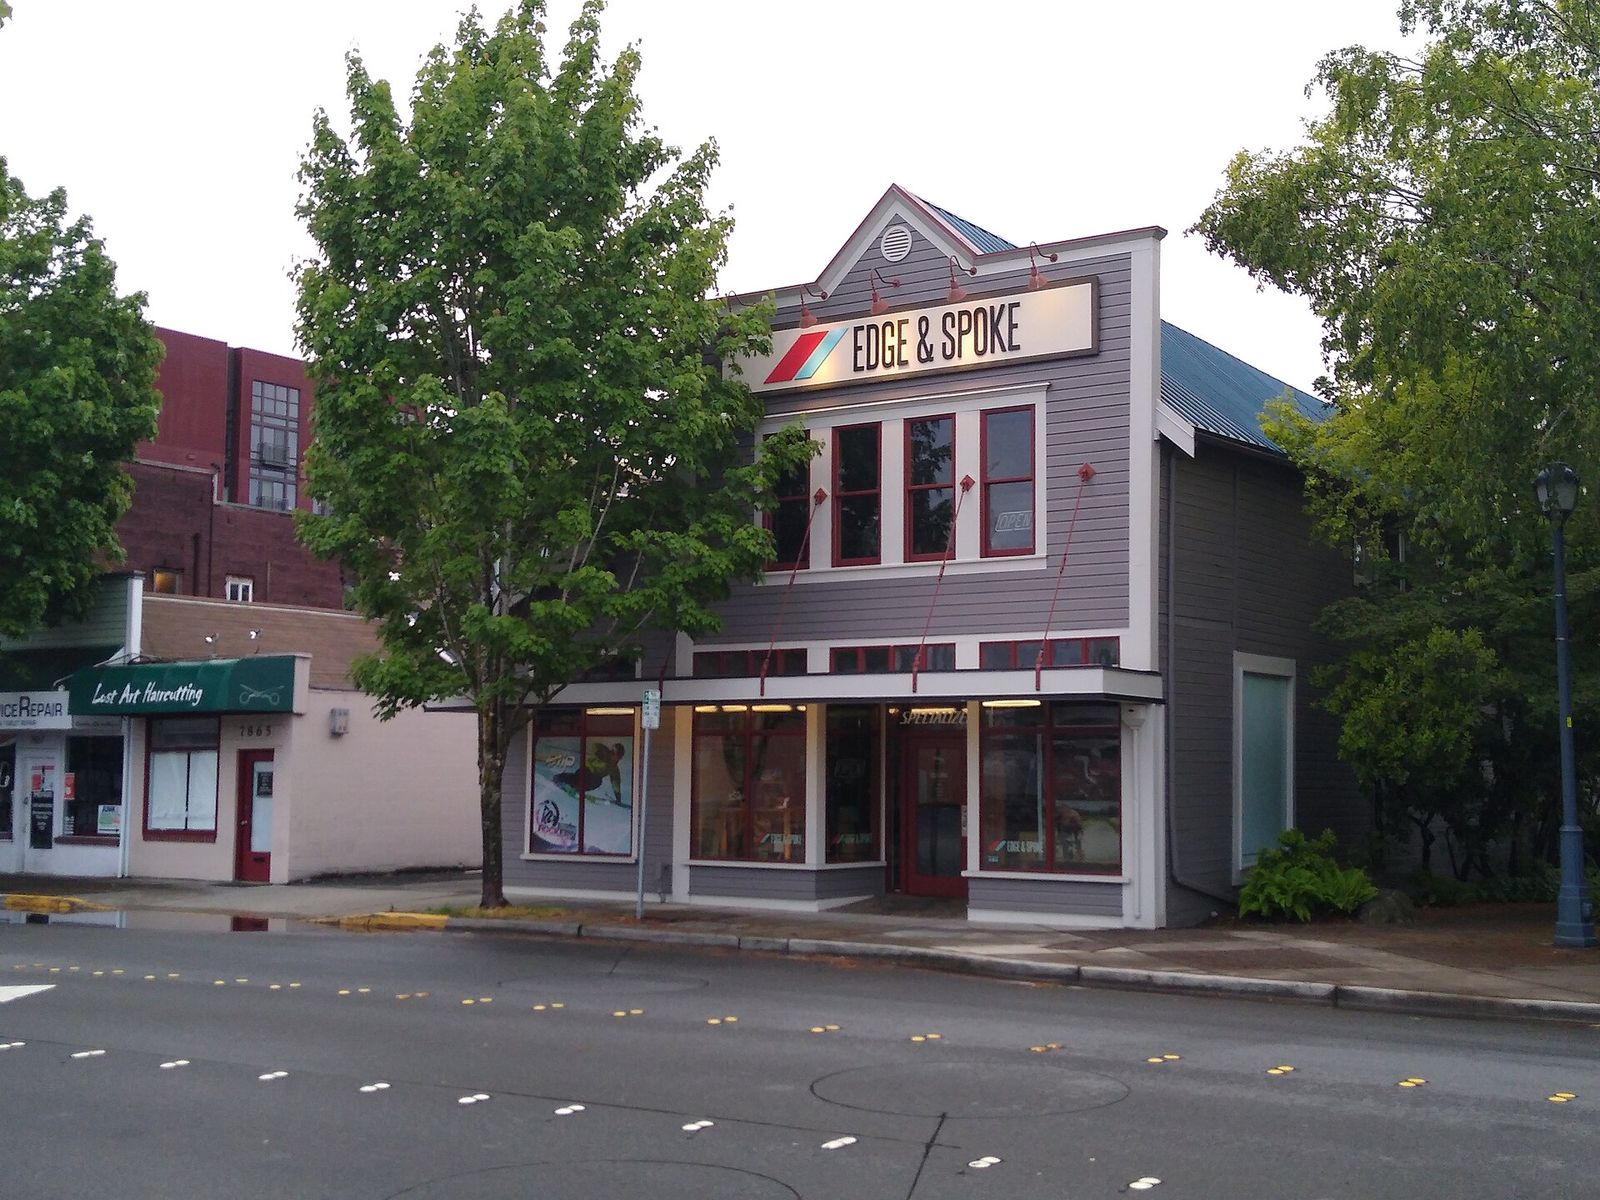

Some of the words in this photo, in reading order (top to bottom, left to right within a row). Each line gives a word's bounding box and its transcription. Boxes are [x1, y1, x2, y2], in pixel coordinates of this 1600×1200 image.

[853, 319, 909, 372] EDGE
[917, 315, 934, 364] &
[942, 301, 1021, 361] SPOKE
[92, 682, 118, 704] Lost
[119, 682, 141, 705] Art
[142, 681, 203, 707] Haircutting
